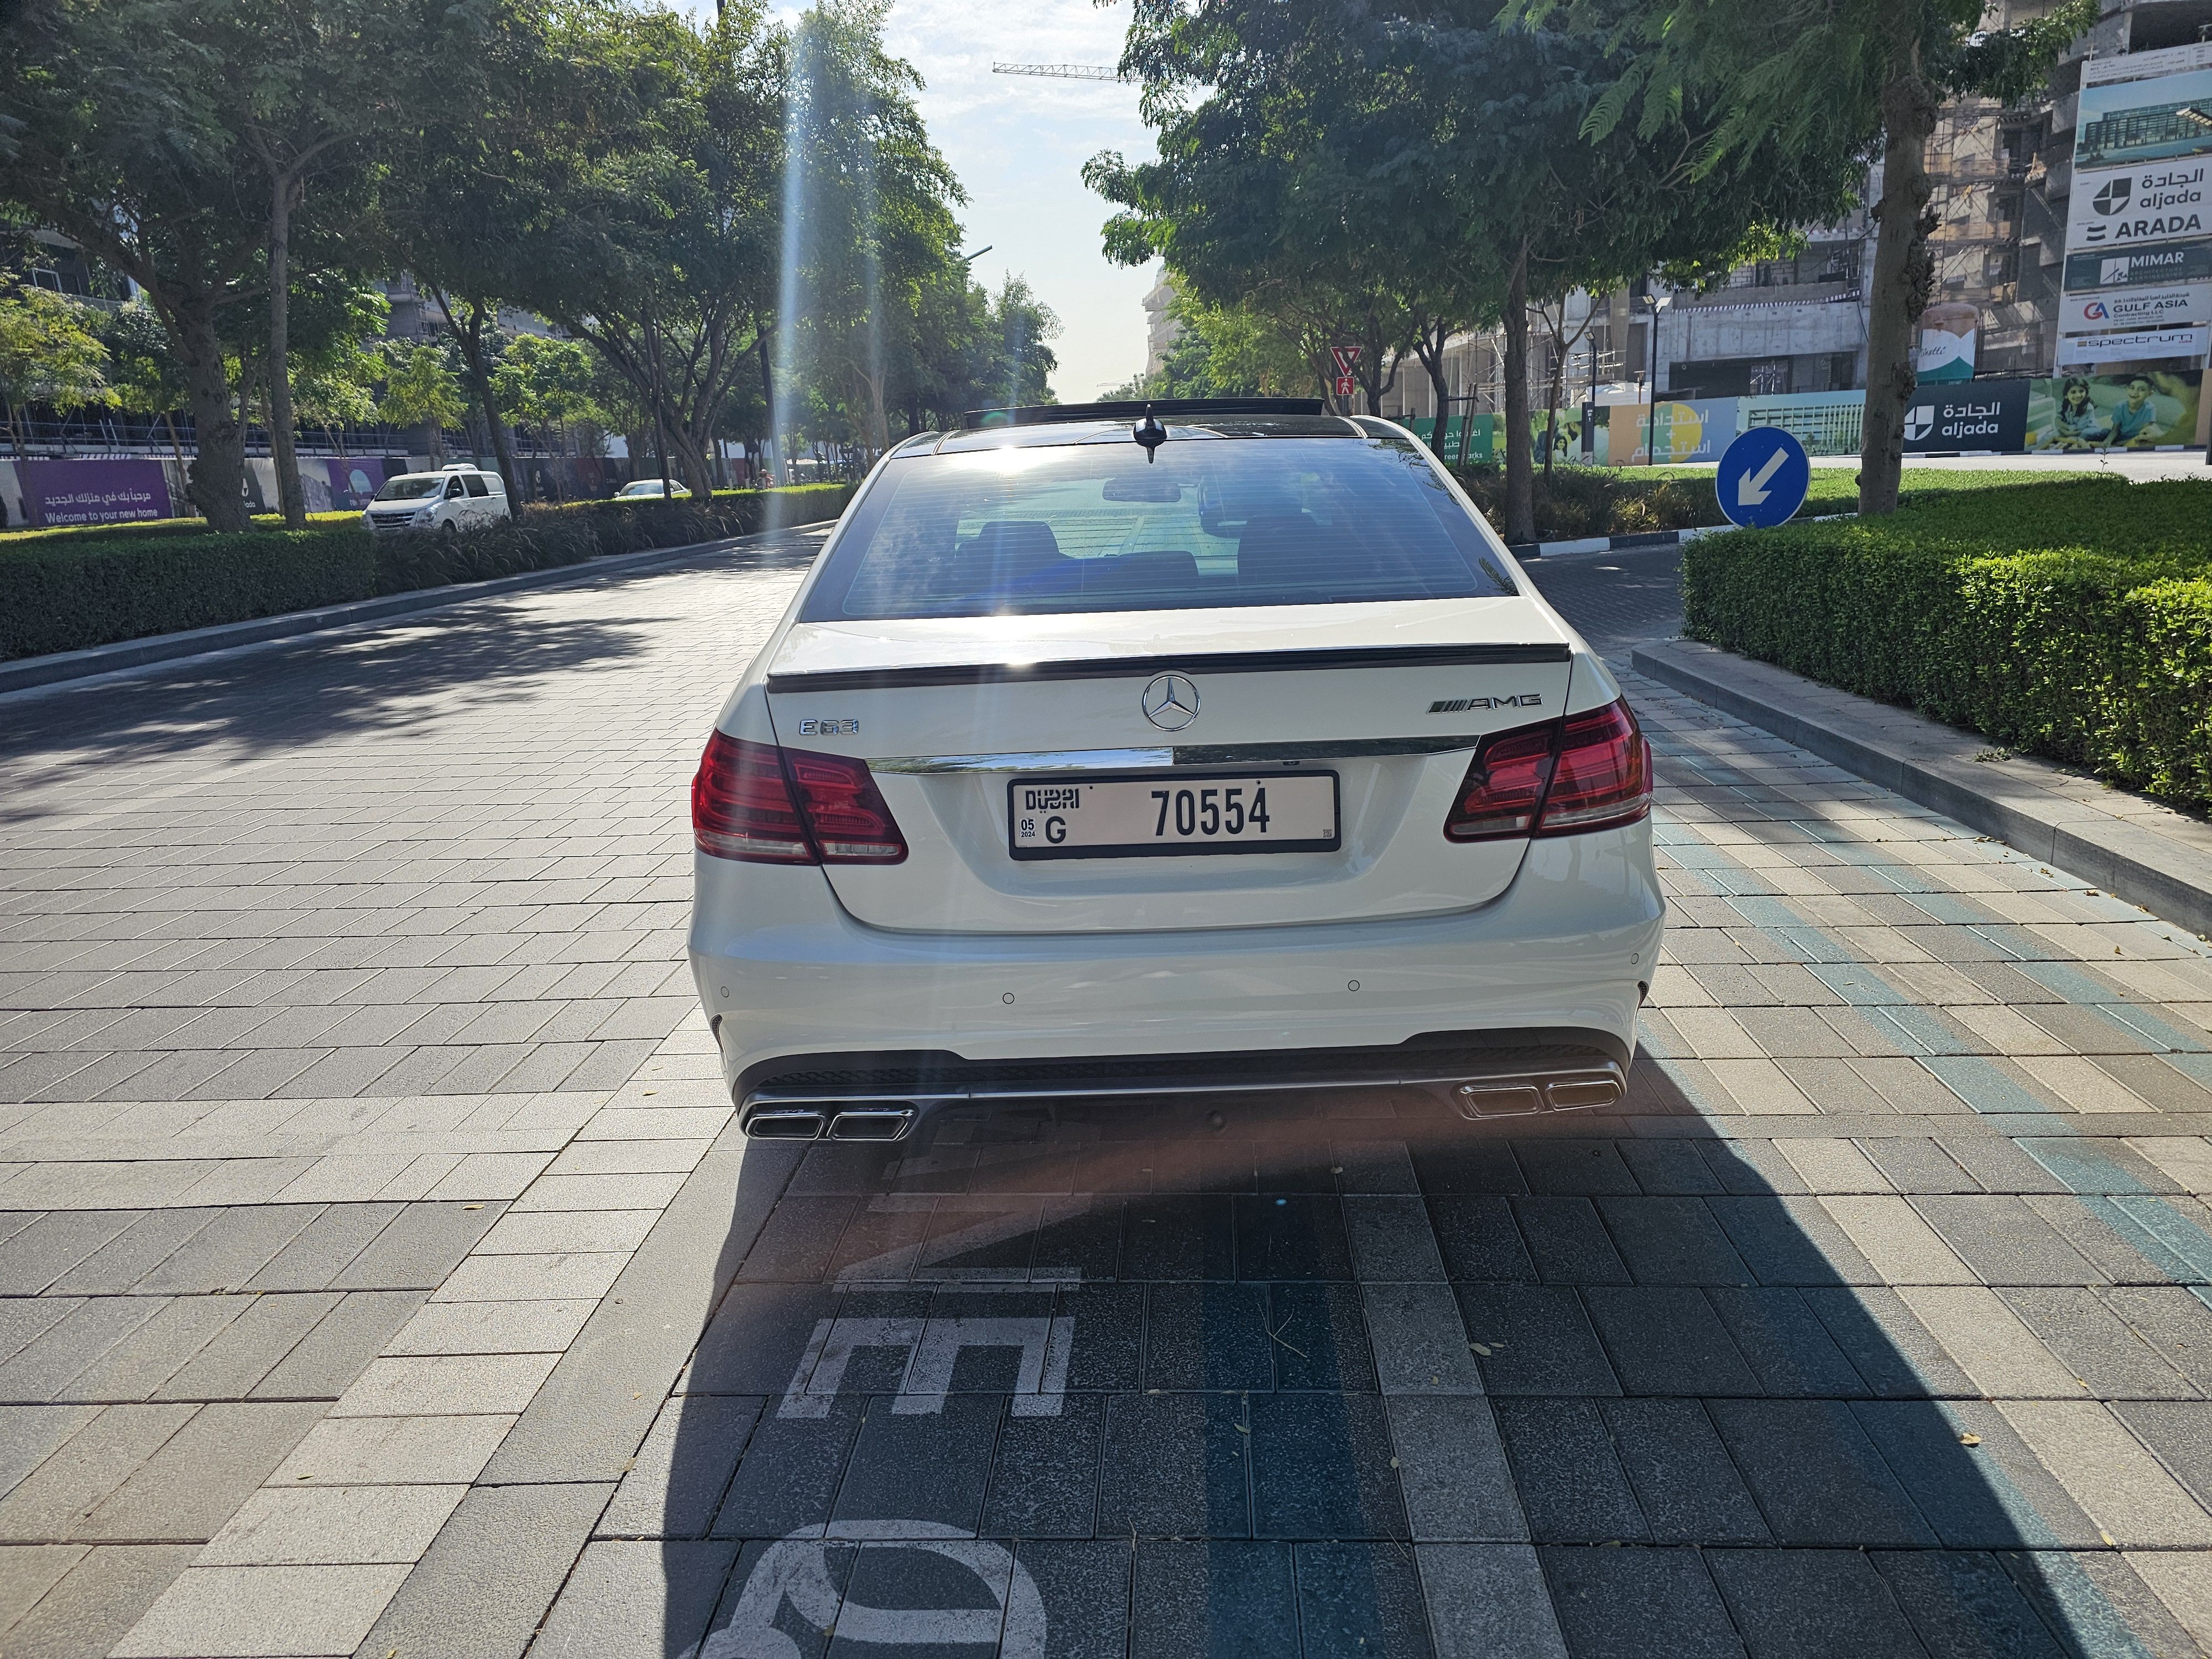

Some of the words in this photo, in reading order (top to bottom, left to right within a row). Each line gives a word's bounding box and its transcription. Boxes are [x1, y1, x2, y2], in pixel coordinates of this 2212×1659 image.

[2142, 168, 2204, 189] الجادة
[2140, 189, 2201, 210] aljada
[2115, 213, 2201, 239] ARADA
[2131, 252, 2184, 268] MIMAR
[2113, 302, 2151, 313] GULF
[2154, 299, 2188, 309] ASIA
[2114, 310, 2150, 319] Contracting
[2088, 333, 2193, 348] spectrum
[1636, 409, 1709, 427] استدامة
[1943, 401, 2001, 420] الجادة
[1942, 420, 1999, 439] aljada
[1631, 440, 1710, 463] استجمام
[45, 494, 74, 507] الجديد
[76, 493, 100, 505] منزلك
[102, 492, 117, 506] في
[45, 512, 87, 524] Welcome
[88, 512, 98, 520] to
[100, 511, 117, 522] your
[119, 510, 136, 519] new
[137, 507, 158, 518] home
[1465, 693, 1543, 712] AMG
[799, 719, 859, 735] E63
[1025, 789, 1079, 810] DUBAI
[1151, 787, 1270, 837] 70554
[1021, 819, 1034, 831] 05
[1045, 816, 1066, 844] G
